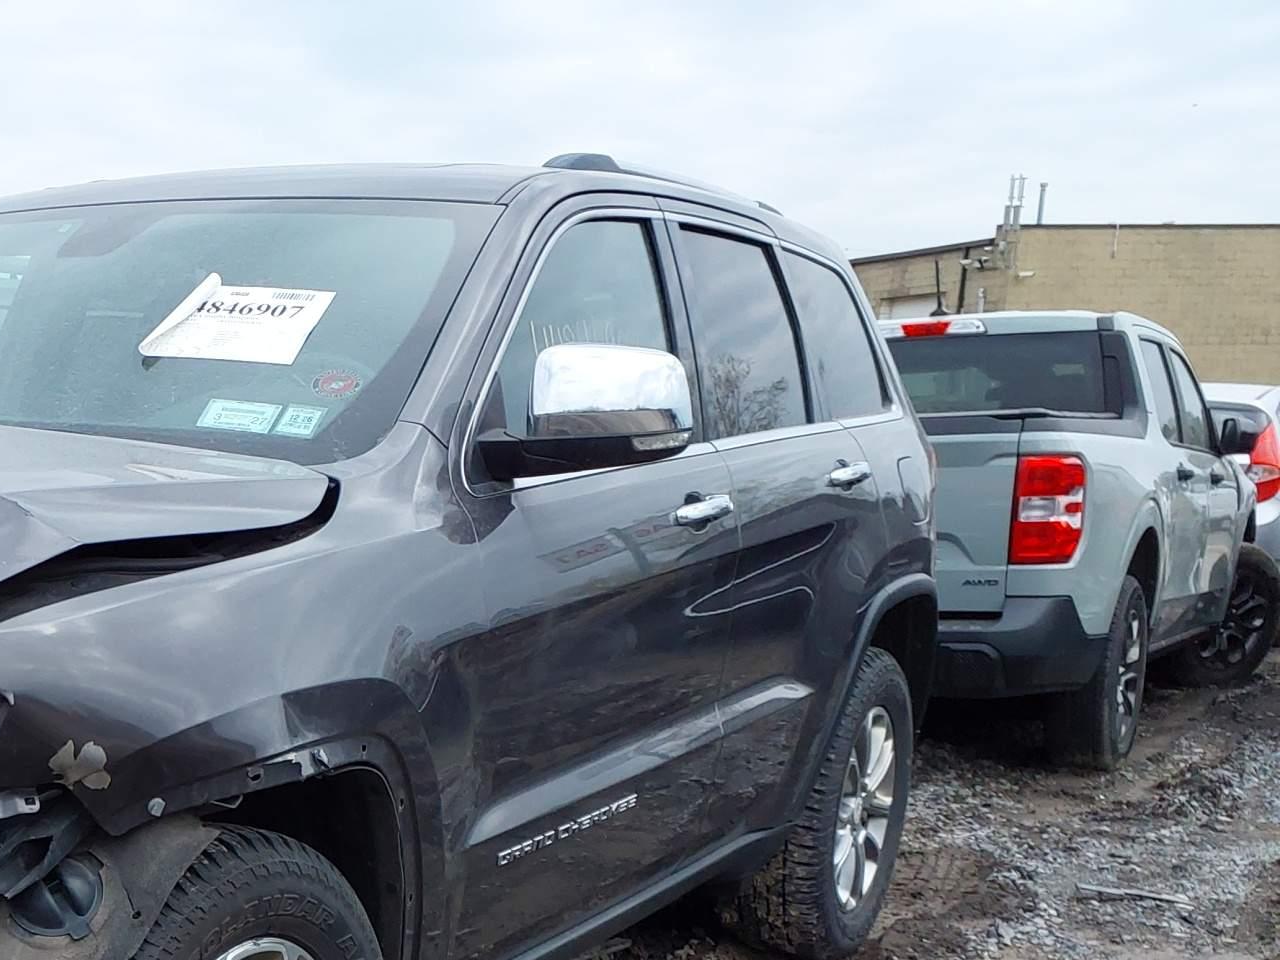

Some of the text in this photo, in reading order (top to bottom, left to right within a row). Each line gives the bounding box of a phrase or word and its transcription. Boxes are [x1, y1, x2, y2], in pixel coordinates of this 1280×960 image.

[961, 578, 999, 587] AWD
[497, 793, 639, 867] GRAND CHEROKEE
